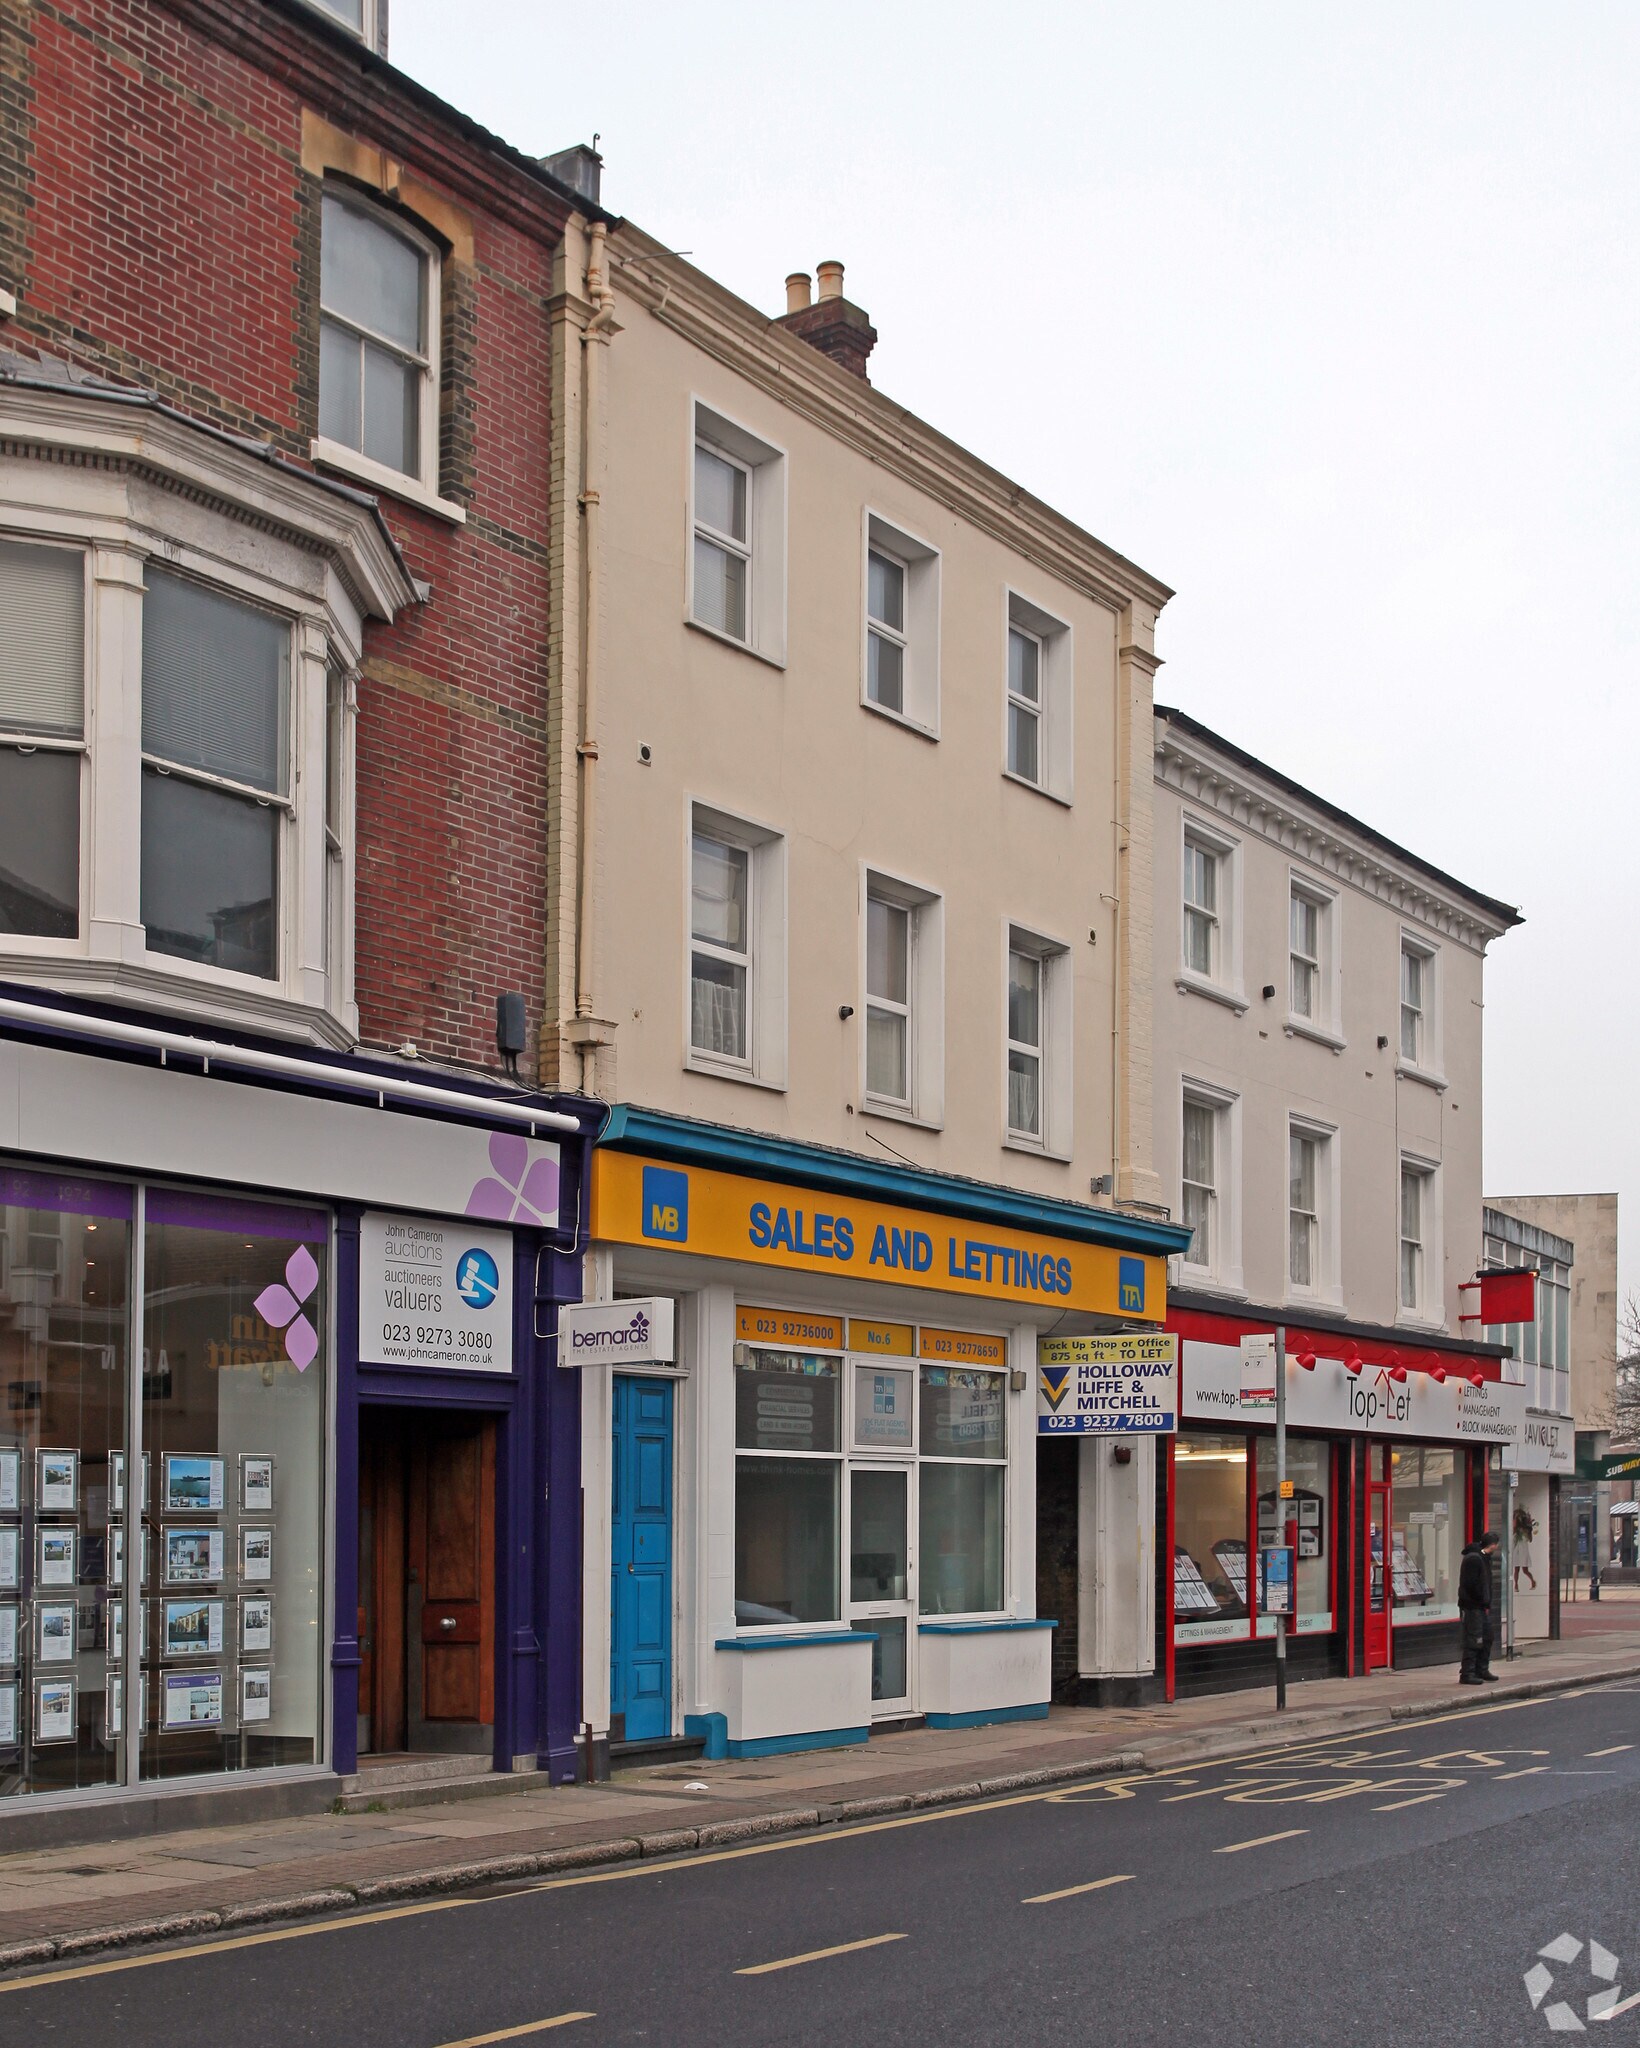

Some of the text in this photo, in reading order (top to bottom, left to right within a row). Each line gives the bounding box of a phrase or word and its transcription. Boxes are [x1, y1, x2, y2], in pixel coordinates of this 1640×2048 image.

[652, 1204, 679, 1233] MB
[385, 1224, 443, 1243] John Cameron
[385, 1241, 443, 1260] auctions
[749, 1202, 1072, 1295] SALES AND LETTINGS
[385, 1270, 442, 1287] auctioneers
[385, 1286, 442, 1312] valuers
[383, 1324, 492, 1349] 023 9273 3080
[573, 1325, 649, 1348] bernards
[757, 1319, 777, 1333] 023
[782, 1322, 834, 1340] 92736000
[935, 1340, 951, 1352] 023
[957, 1342, 998, 1358] 92778650
[1043, 1341, 1067, 1351] Lock
[1072, 1341, 1086, 1351] Up
[1090, 1340, 1117, 1350] Shop
[1137, 1338, 1170, 1347] Office
[383, 1346, 493, 1364] www.johncameron.co.uk
[1051, 1352, 1070, 1360] 875
[1076, 1352, 1089, 1362] sq
[1094, 1350, 1105, 1360] ft
[1119, 1349, 1136, 1358] TO
[1141, 1349, 1162, 1358] LET
[1078, 1364, 1173, 1379] HOLLOWAY
[1078, 1380, 1144, 1394] ILIFFE &
[1464, 1386, 1488, 1399] LETTINGS
[1077, 1396, 1160, 1409] MITCHELL
[1463, 1405, 1500, 1417] MANAGEMENT
[1048, 1414, 1163, 1427] 023 9237 7800
[1462, 1421, 1517, 1436] BLOCK MANAGEMENT
[1605, 1458, 1640, 1478] SUBWAY
[1179, 1628, 1199, 1638] LETTINGS
[1204, 1625, 1234, 1635] MANAGEMENT
[1235, 1749, 1549, 1769] BUS
[1045, 1778, 1468, 1802] STOP
